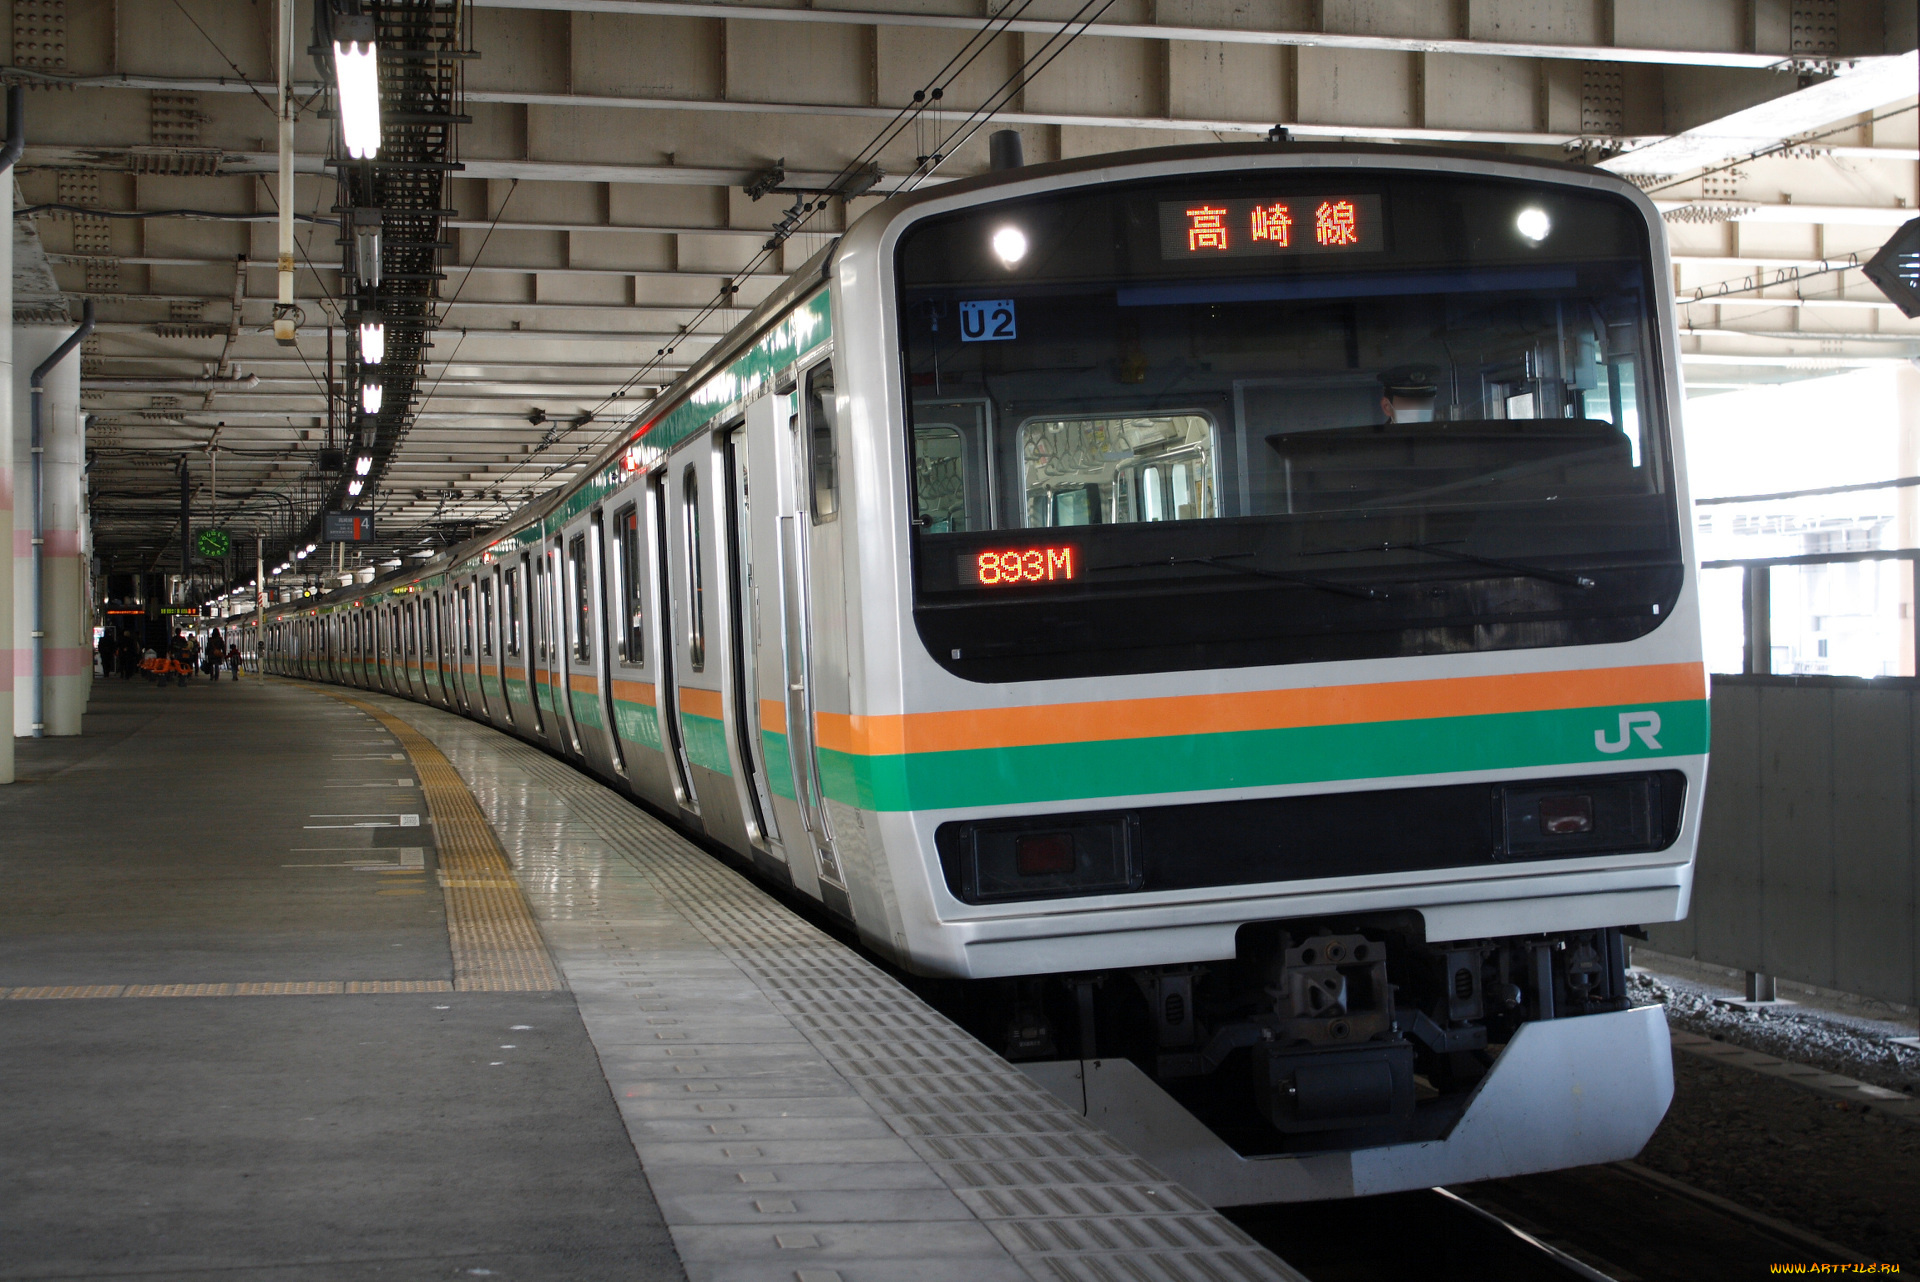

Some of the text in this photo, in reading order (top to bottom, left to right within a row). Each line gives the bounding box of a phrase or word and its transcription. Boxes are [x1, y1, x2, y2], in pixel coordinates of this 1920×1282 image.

[1186, 201, 1357, 251] 高崎線
[962, 308, 1014, 338] U2
[360, 517, 370, 530] 4
[978, 547, 1072, 585] 893M
[1594, 710, 1663, 754] JR
